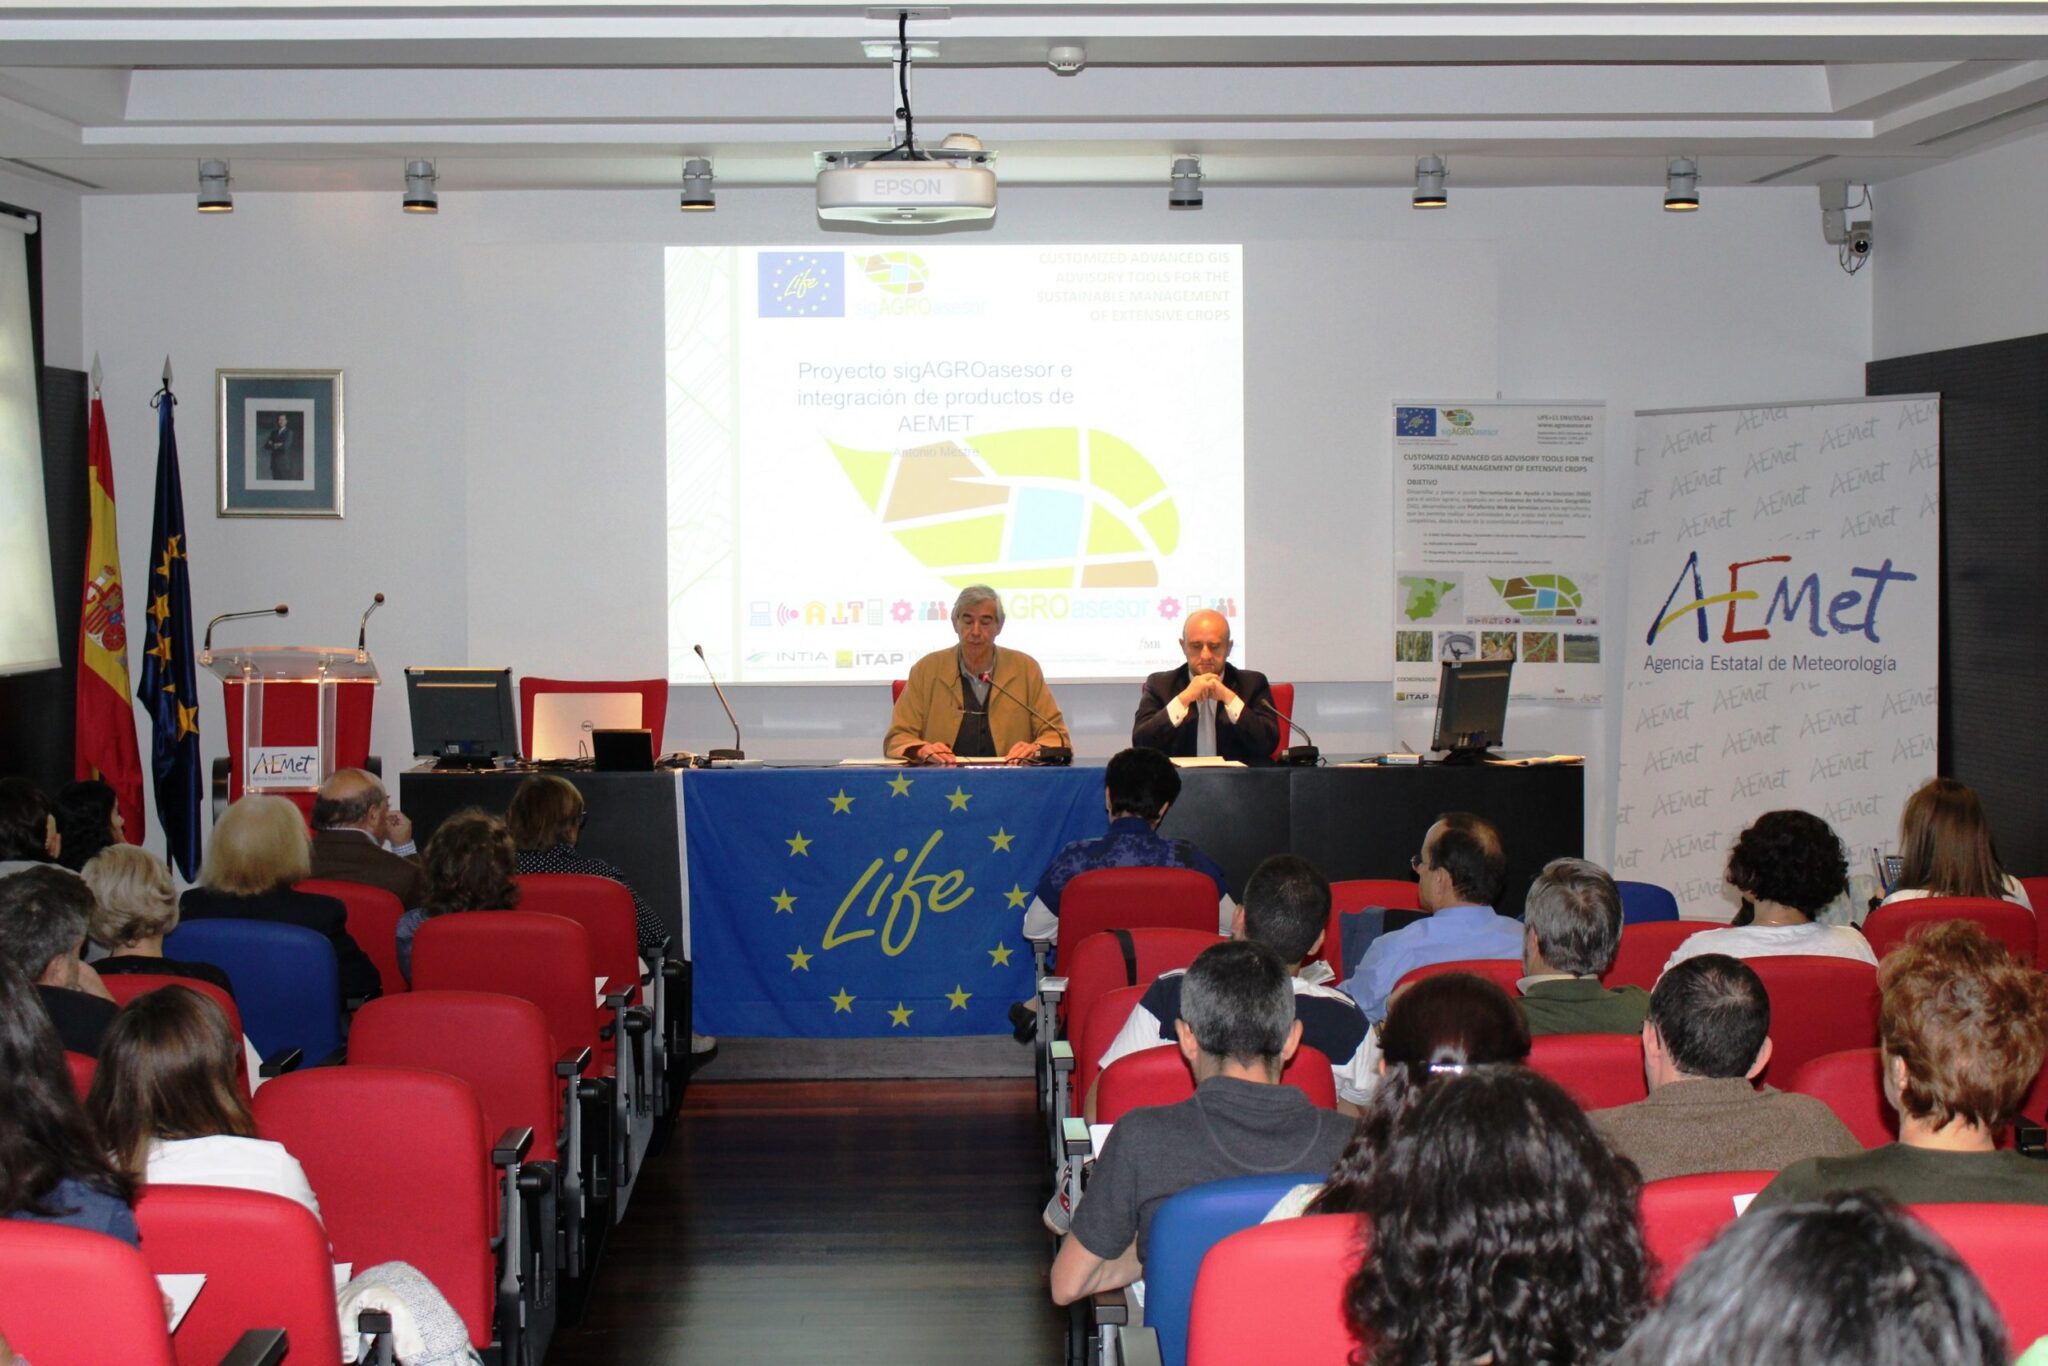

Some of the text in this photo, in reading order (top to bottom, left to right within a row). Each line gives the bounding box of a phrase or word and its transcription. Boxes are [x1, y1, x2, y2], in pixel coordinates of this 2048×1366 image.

[874, 179, 941, 196] EPSON
[1039, 251, 1230, 264] CUSTOMIZED ADVANCED GIS
[783, 266, 819, 299] Life
[1056, 271, 1230, 283] ADVISORY TOOLS FOR THE
[1036, 290, 1230, 303] SUSTAINABLE MANAGEMENT
[1090, 309, 1231, 321] OF EXTENSIVE CROPS
[798, 361, 1073, 384] Proyecto sigAGROasesor e
[797, 387, 1074, 410] integración de productos de
[897, 415, 975, 432] AEMET
[1819, 416, 1881, 454] AEMet
[893, 446, 980, 458] Antonio Mestre
[1660, 423, 1718, 458] AEMet
[1460, 464, 1513, 472] MANAGEMENT
[1743, 440, 1803, 478] AEMet
[1669, 465, 1727, 500] AEMet
[1829, 461, 1890, 498] AEMet
[1753, 484, 1812, 520] AEMet
[1677, 507, 1737, 542] AEMet
[1840, 505, 1902, 539] AEMet
[1006, 591, 1150, 621] GROasesor
[1645, 550, 1918, 647] AEMet
[777, 652, 829, 663] INTIA
[855, 653, 905, 666] ITAP
[1643, 655, 1897, 675] Agencia Estatal de Meteorología
[1712, 682, 1773, 714] AEMet
[1634, 699, 1696, 733] AEMet
[1799, 705, 1863, 739] AEMet
[1721, 724, 1783, 758] AEMet
[252, 753, 316, 775] AEMet
[1643, 743, 1704, 776] AEMet
[1810, 749, 1873, 784] AEMet
[1730, 767, 1792, 802] AEMet
[1652, 786, 1713, 819] AEMet
[1660, 831, 1722, 862] AEMet
[821, 828, 976, 958] Life
